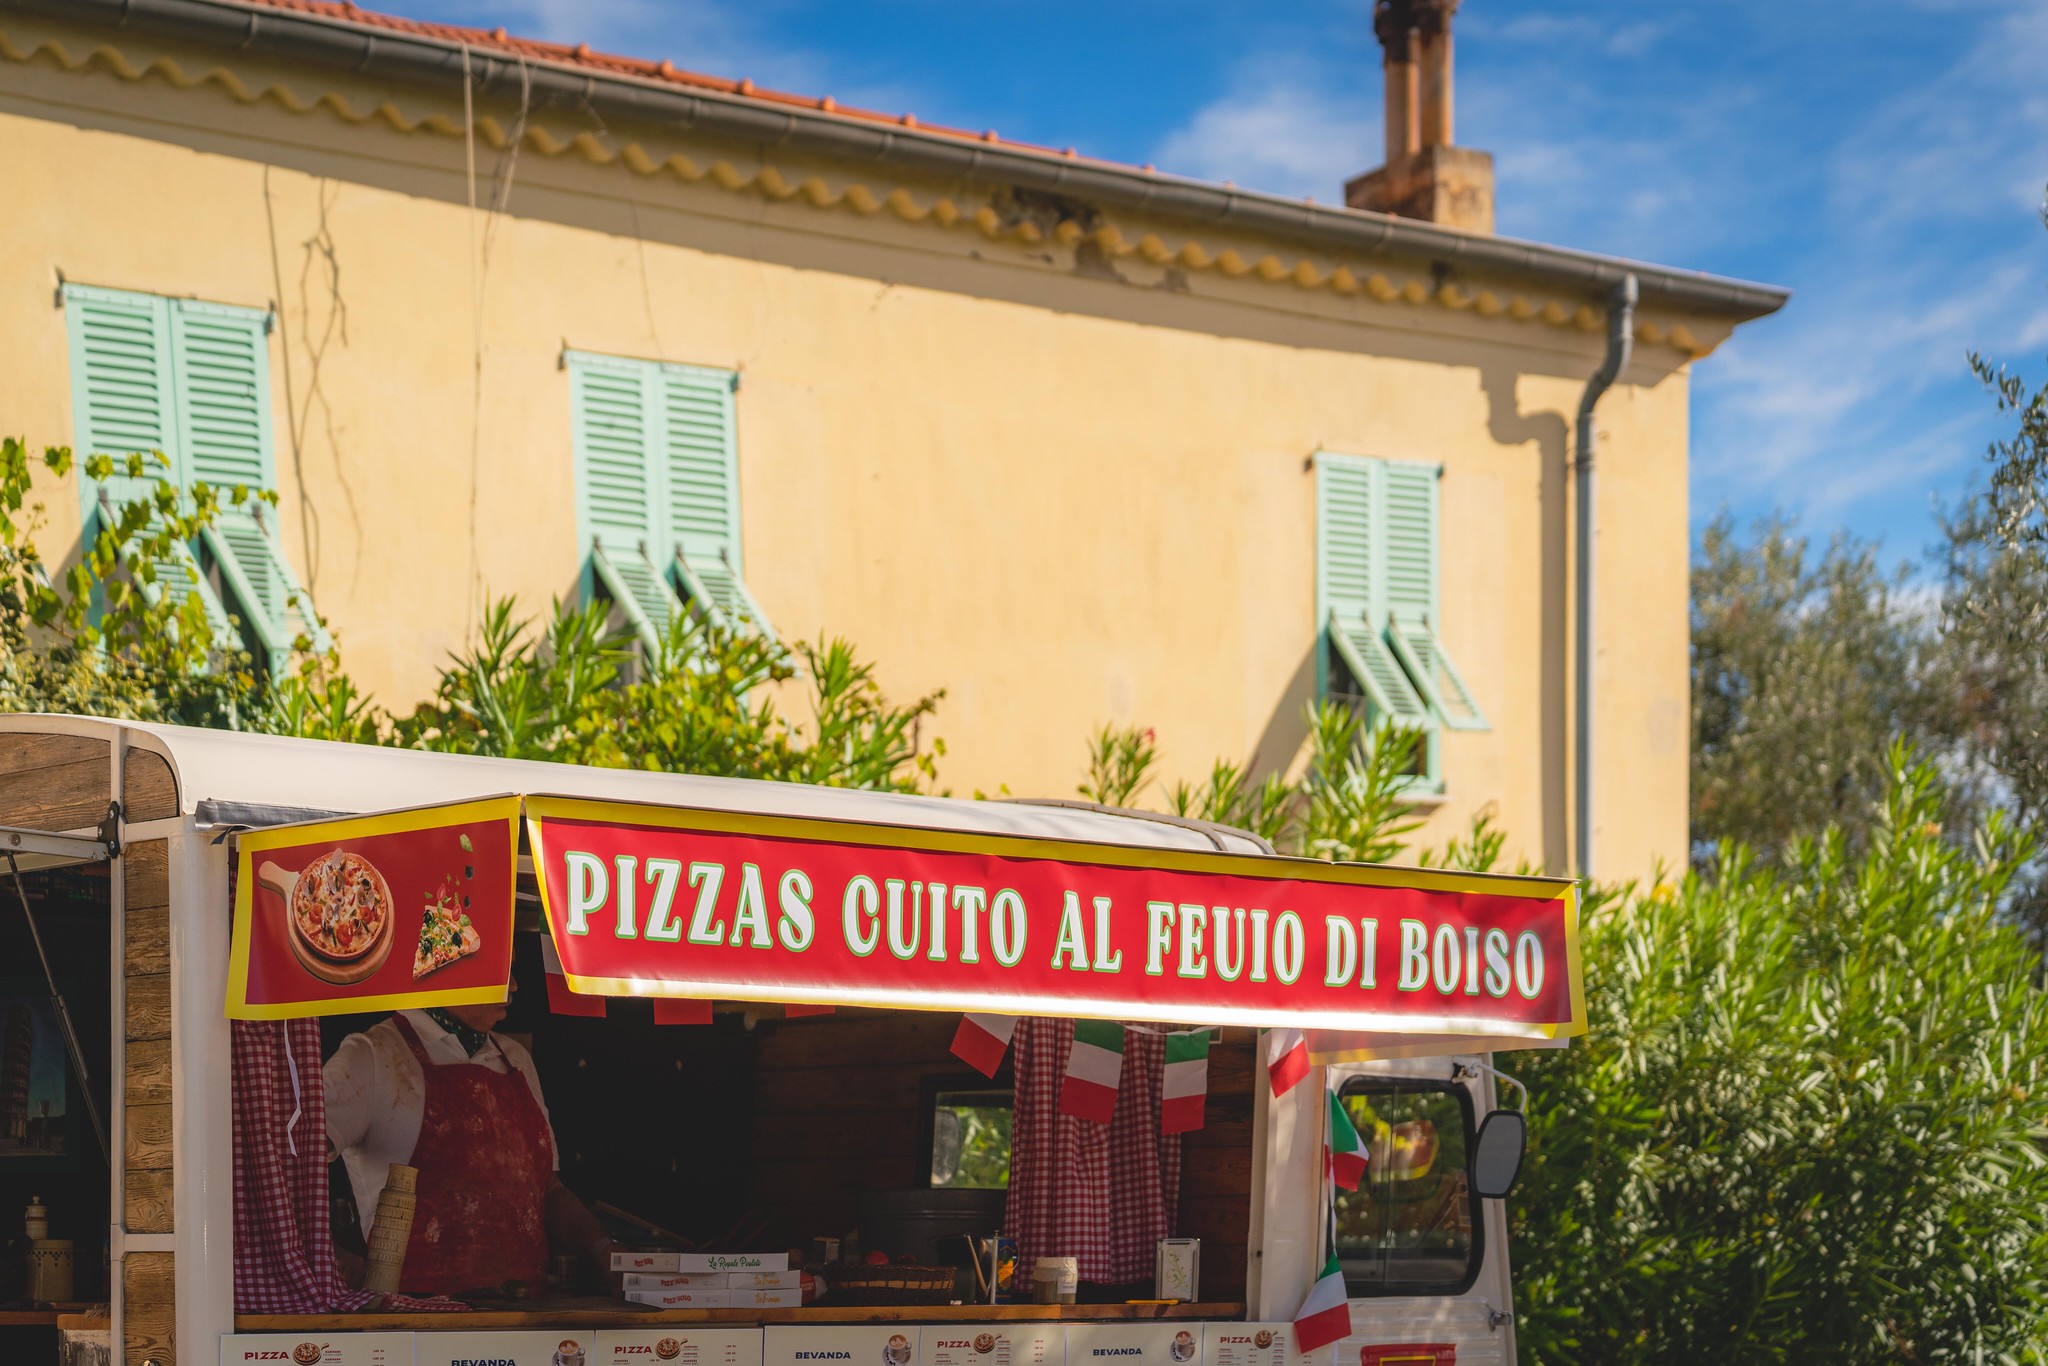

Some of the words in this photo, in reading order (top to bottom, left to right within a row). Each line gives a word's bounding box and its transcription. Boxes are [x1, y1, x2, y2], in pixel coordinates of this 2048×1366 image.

[564, 851, 815, 952] PIZZAS
[842, 874, 1028, 967] CUITO
[1051, 890, 1123, 973] AL
[1145, 901, 1306, 985] FEUIO
[1324, 914, 1378, 989] DI
[1398, 918, 1544, 999] BOISO
[614, 1346, 653, 1354] PIZZA
[1093, 1348, 1143, 1356] BEVANDA
[244, 1351, 289, 1360] PIZZA
